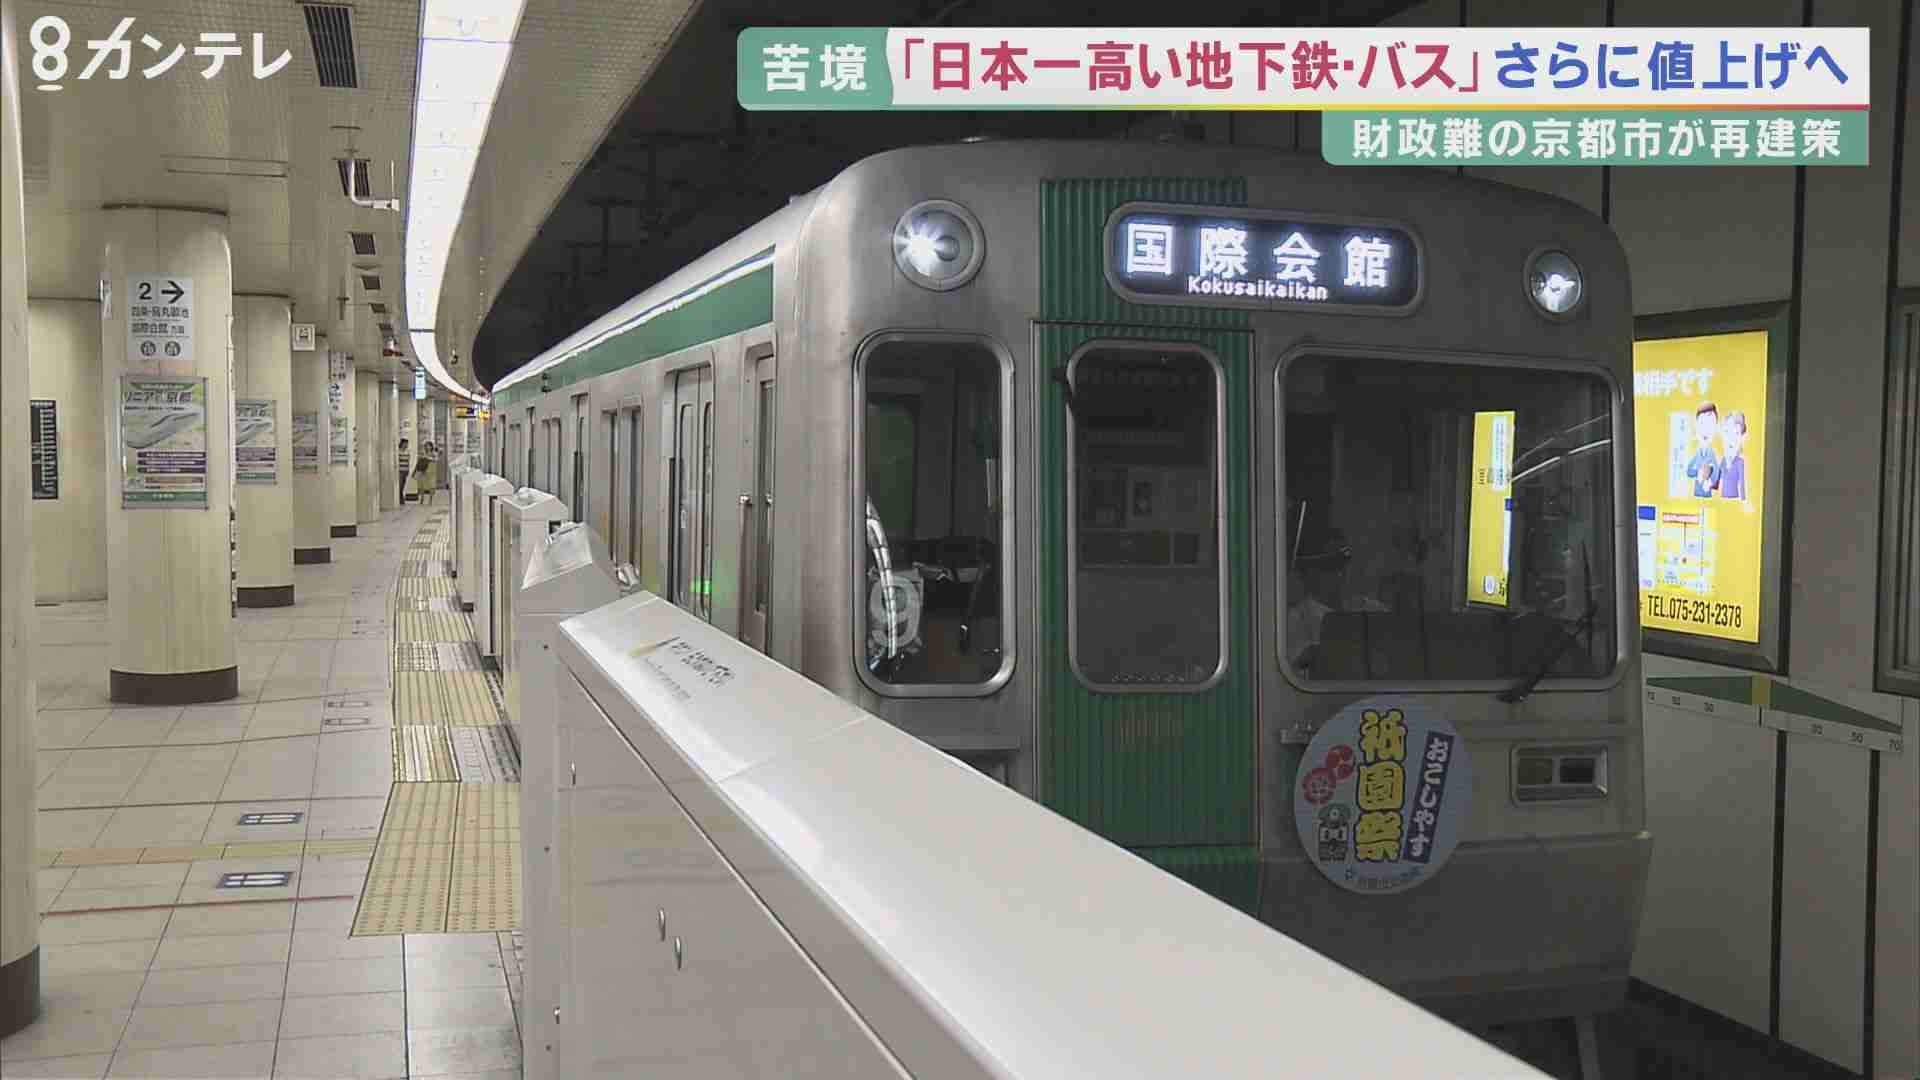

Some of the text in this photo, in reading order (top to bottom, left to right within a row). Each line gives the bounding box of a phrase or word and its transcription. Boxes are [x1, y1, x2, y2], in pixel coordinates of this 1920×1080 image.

[1126, 221, 1393, 289] 国際会館
[139, 282, 152, 300] 2
[1188, 276, 1328, 301] Kokusaikaikan
[1648, 595, 1742, 628] TEL.075-231-2378
[1353, 708, 1408, 863] 祇園祭
[1409, 736, 1449, 857] おこしやす
